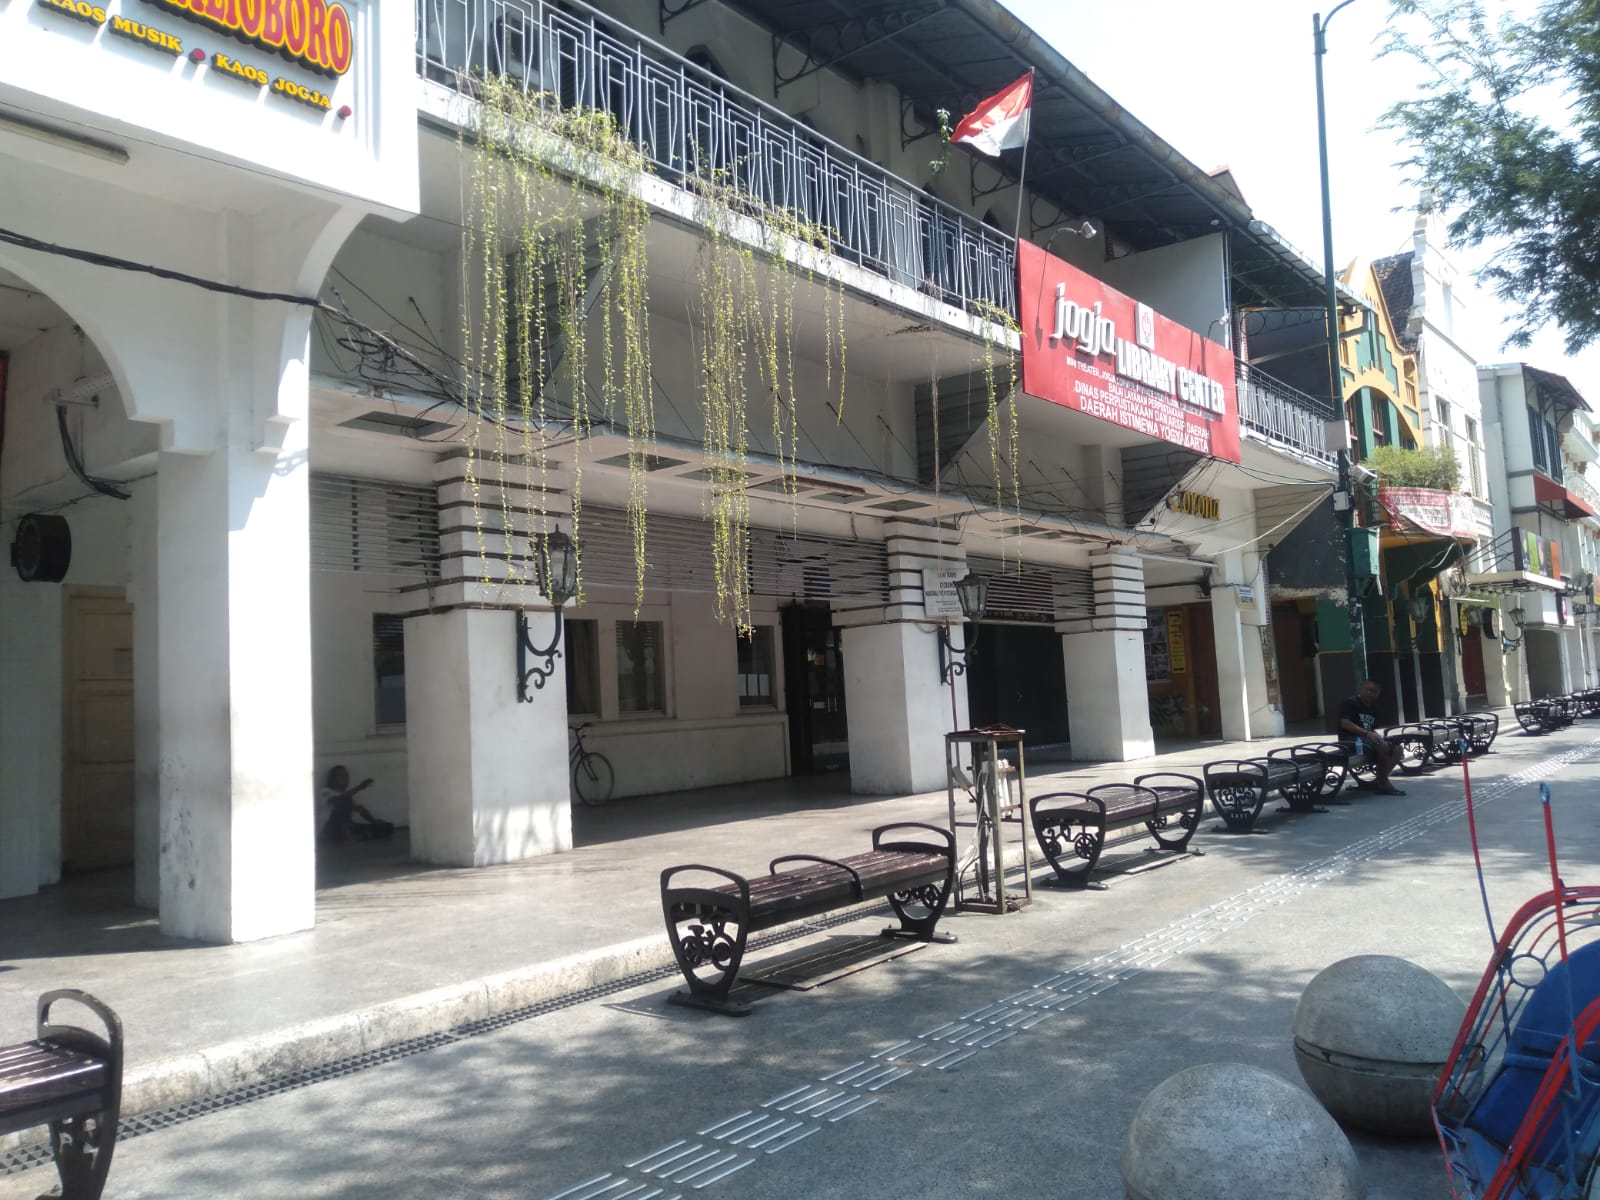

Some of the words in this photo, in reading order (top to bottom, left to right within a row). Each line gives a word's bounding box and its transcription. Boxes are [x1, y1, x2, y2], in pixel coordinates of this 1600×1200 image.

[113, 15, 183, 52] MUSIK
[216, 53, 268, 85] KAOS
[274, 77, 332, 109] JOGJA
[163, 0, 351, 74] OBORO
[1050, 281, 1117, 356] jogja
[1075, 380, 1099, 399] DINAS
[1100, 389, 1154, 420] PERPUSTAKAAN
[1154, 409, 1169, 425] DAN
[1168, 415, 1185, 430] ARSIP
[1186, 422, 1210, 440] DAERAH
[1108, 382, 1124, 397] BALAI
[1124, 387, 1148, 405] LAYANAN
[1115, 337, 1176, 395] LIBRARY
[1177, 366, 1226, 416] CENTER
[1080, 395, 1118, 422] DAERAH
[1120, 410, 1159, 437] ISTIMEWA
[1160, 423, 1209, 453] YOGYAKARTA
